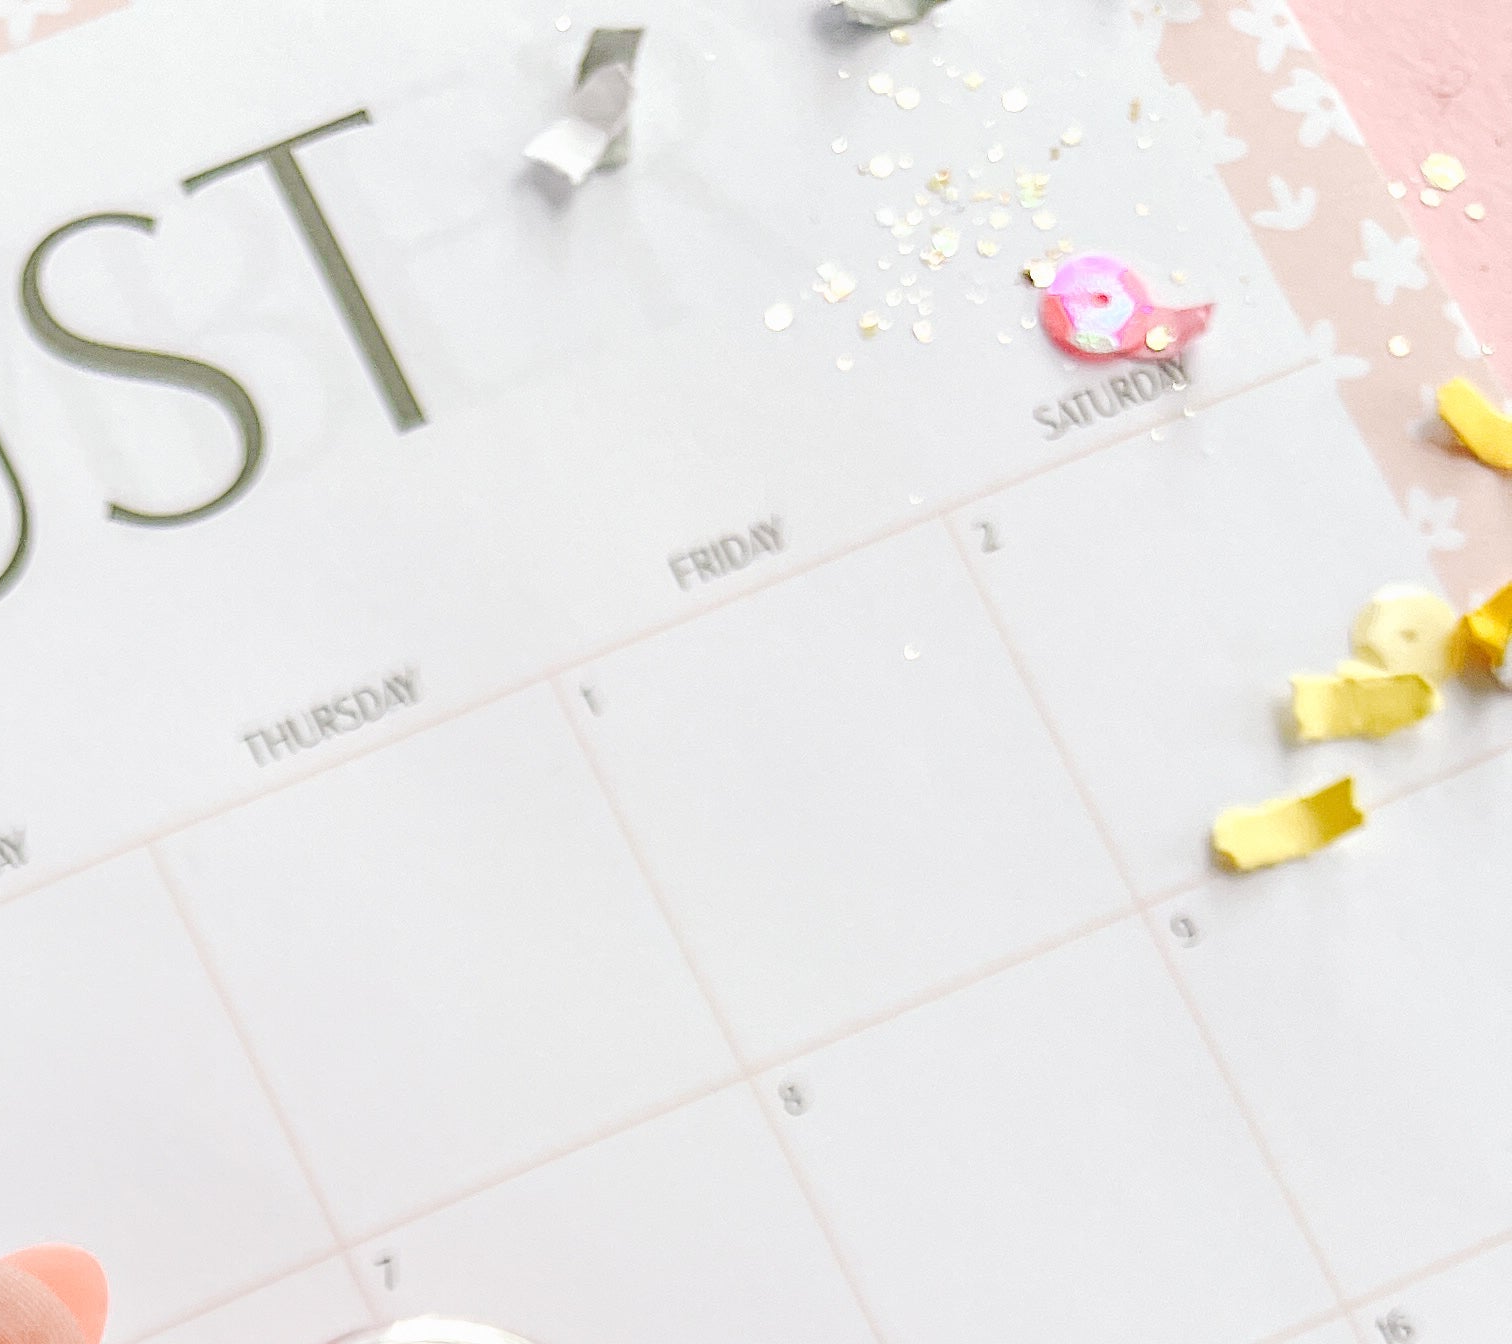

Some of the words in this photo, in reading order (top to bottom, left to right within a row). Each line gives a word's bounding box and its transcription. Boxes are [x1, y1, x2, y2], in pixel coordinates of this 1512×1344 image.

[1031, 352, 1193, 441] SATURDAY
[667, 515, 785, 592] FRIDAY
[976, 522, 1001, 554] 2
[242, 668, 420, 767] THURSDAY
[581, 686, 600, 715] 1
[1169, 914, 1200, 947] 9
[778, 1080, 809, 1116] 8
[372, 1253, 398, 1290] 7
